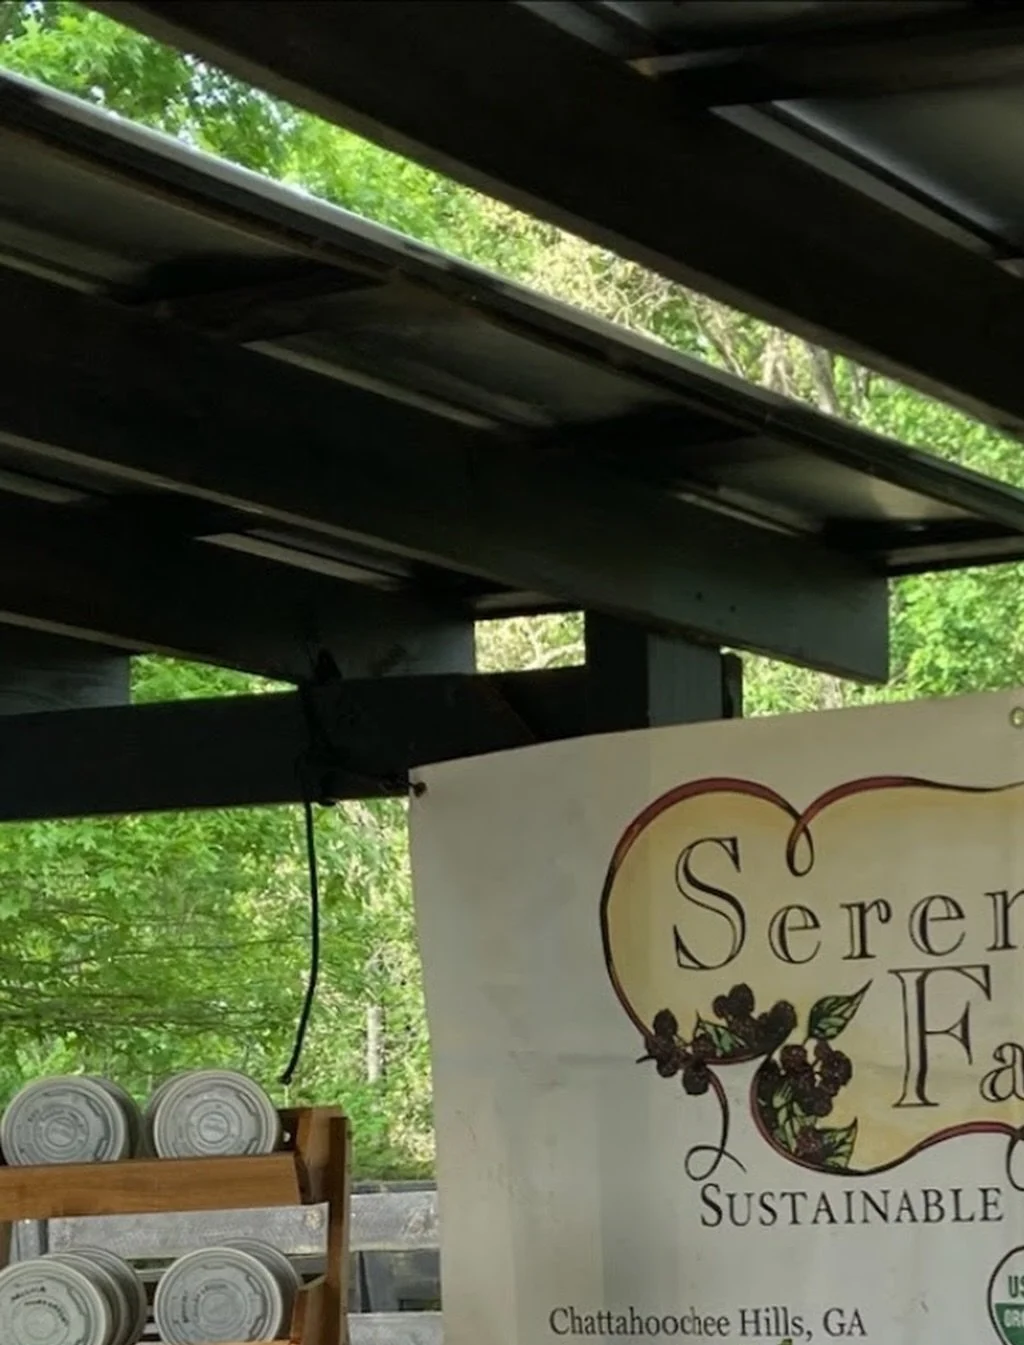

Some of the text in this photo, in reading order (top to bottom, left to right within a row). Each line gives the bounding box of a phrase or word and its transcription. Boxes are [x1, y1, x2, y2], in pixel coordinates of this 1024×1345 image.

[699, 1182, 1003, 1228] SUSTAINABLE
[549, 1306, 867, 1342] Chattahoochee Hills, GA
